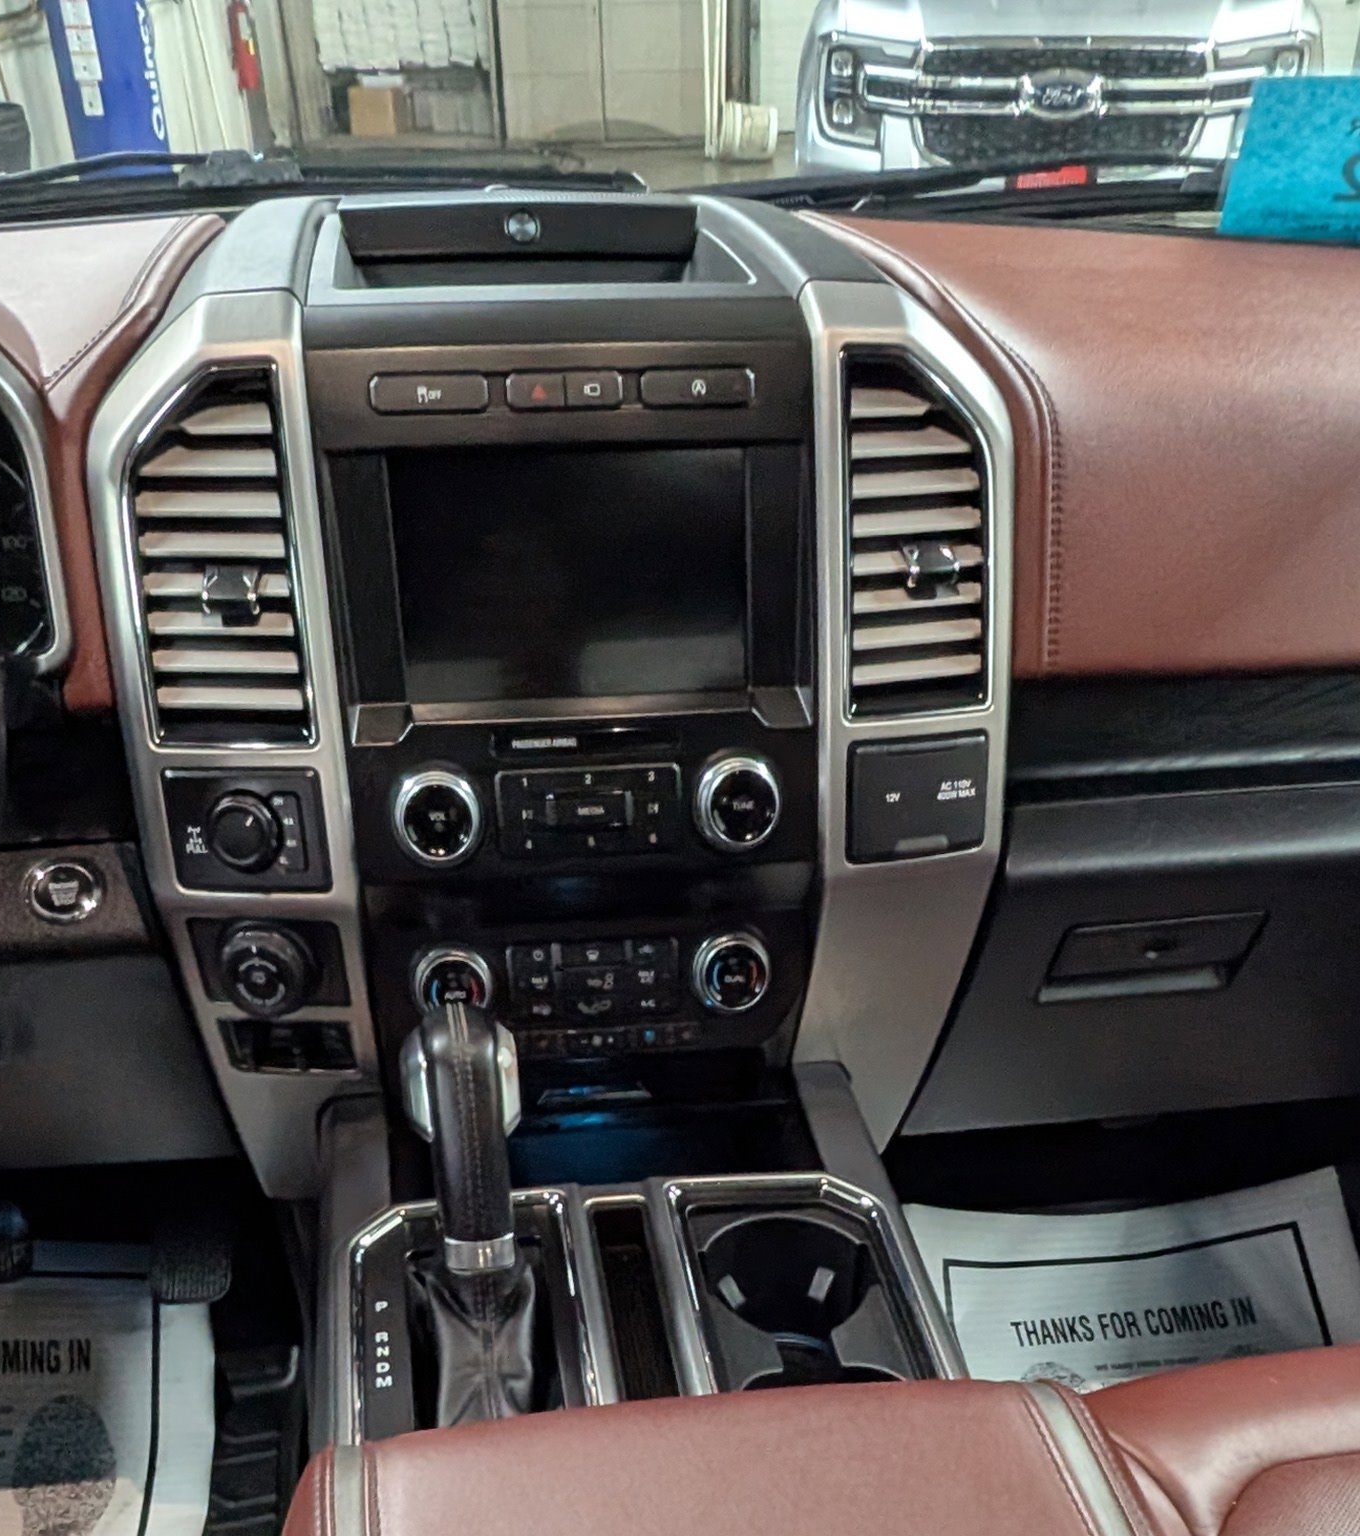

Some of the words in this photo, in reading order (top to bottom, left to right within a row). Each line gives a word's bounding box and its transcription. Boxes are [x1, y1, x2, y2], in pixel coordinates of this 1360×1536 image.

[136, 0, 165, 141] Quincy
[428, 389, 442, 400] OFF
[885, 792, 901, 803] 12V
[444, 990, 467, 1000] AUTO
[375, 1301, 388, 1313] P
[1010, 1314, 1095, 1348] THANKS
[1097, 1310, 1142, 1341] FOR
[1144, 1300, 1229, 1337] COMING
[1232, 1296, 1258, 1326] IN
[375, 1331, 389, 1343] R
[69, 1337, 90, 1374] IN
[376, 1345, 390, 1357] N
[376, 1362, 391, 1374] D
[376, 1375, 393, 1388] M
